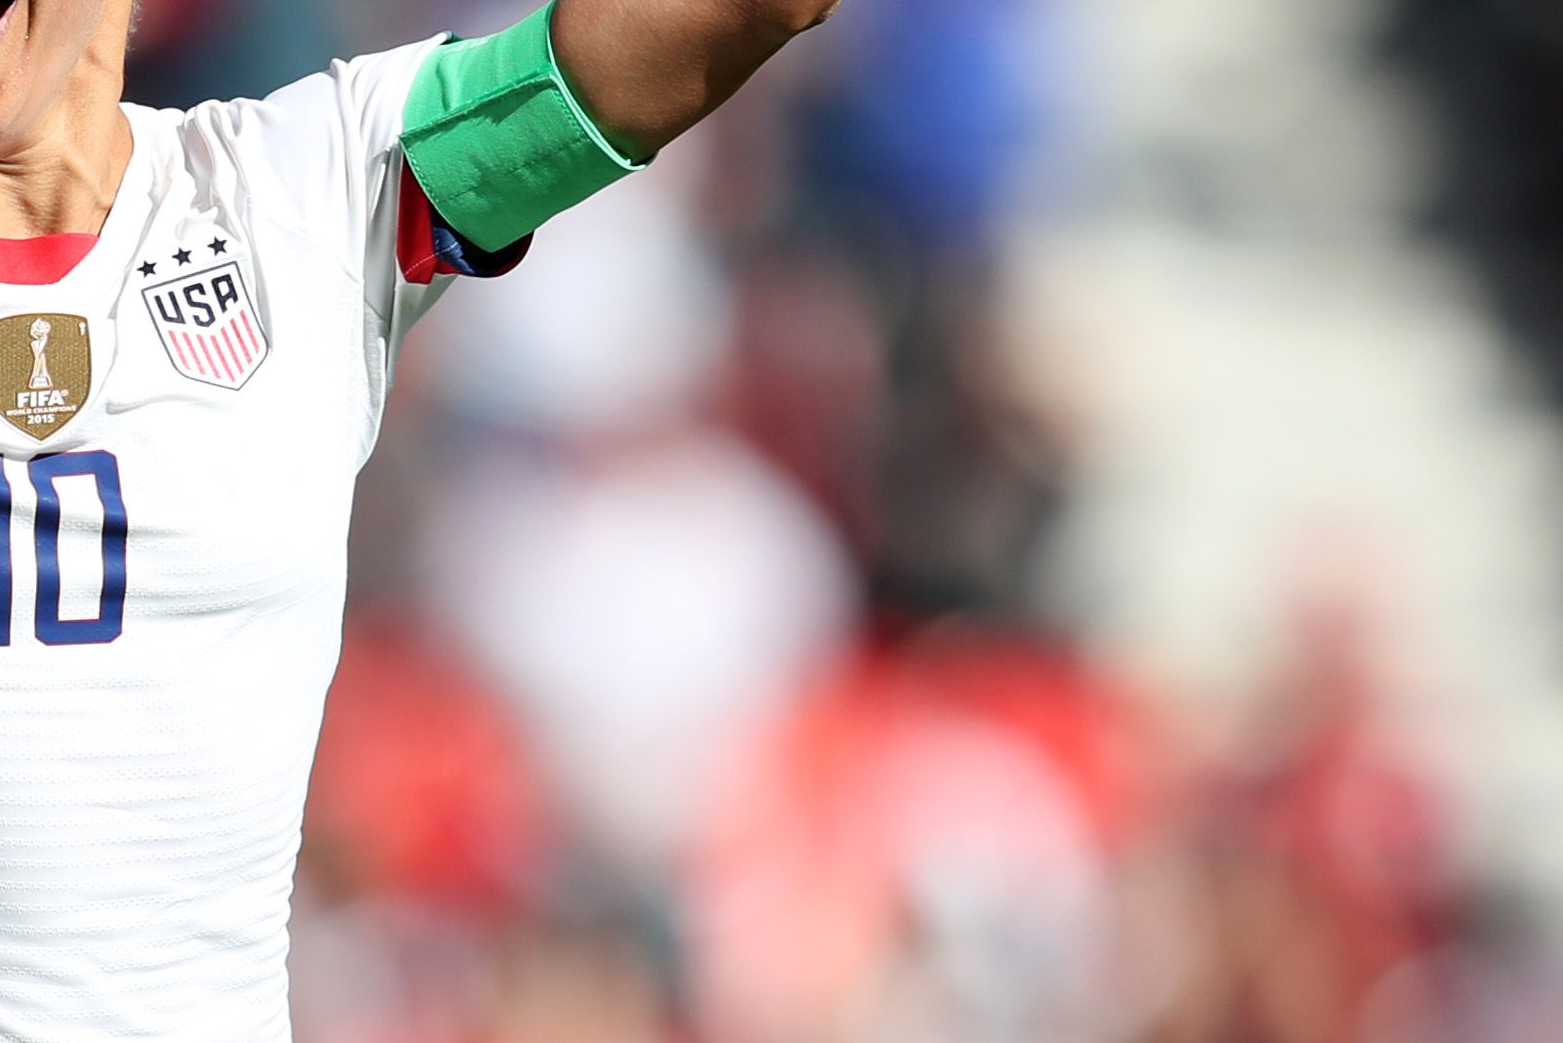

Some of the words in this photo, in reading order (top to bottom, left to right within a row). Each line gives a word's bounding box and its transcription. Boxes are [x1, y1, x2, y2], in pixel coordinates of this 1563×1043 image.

[154, 274, 238, 328] USA
[6, 408, 31, 416] WORLD
[28, 414, 54, 424] 2015
